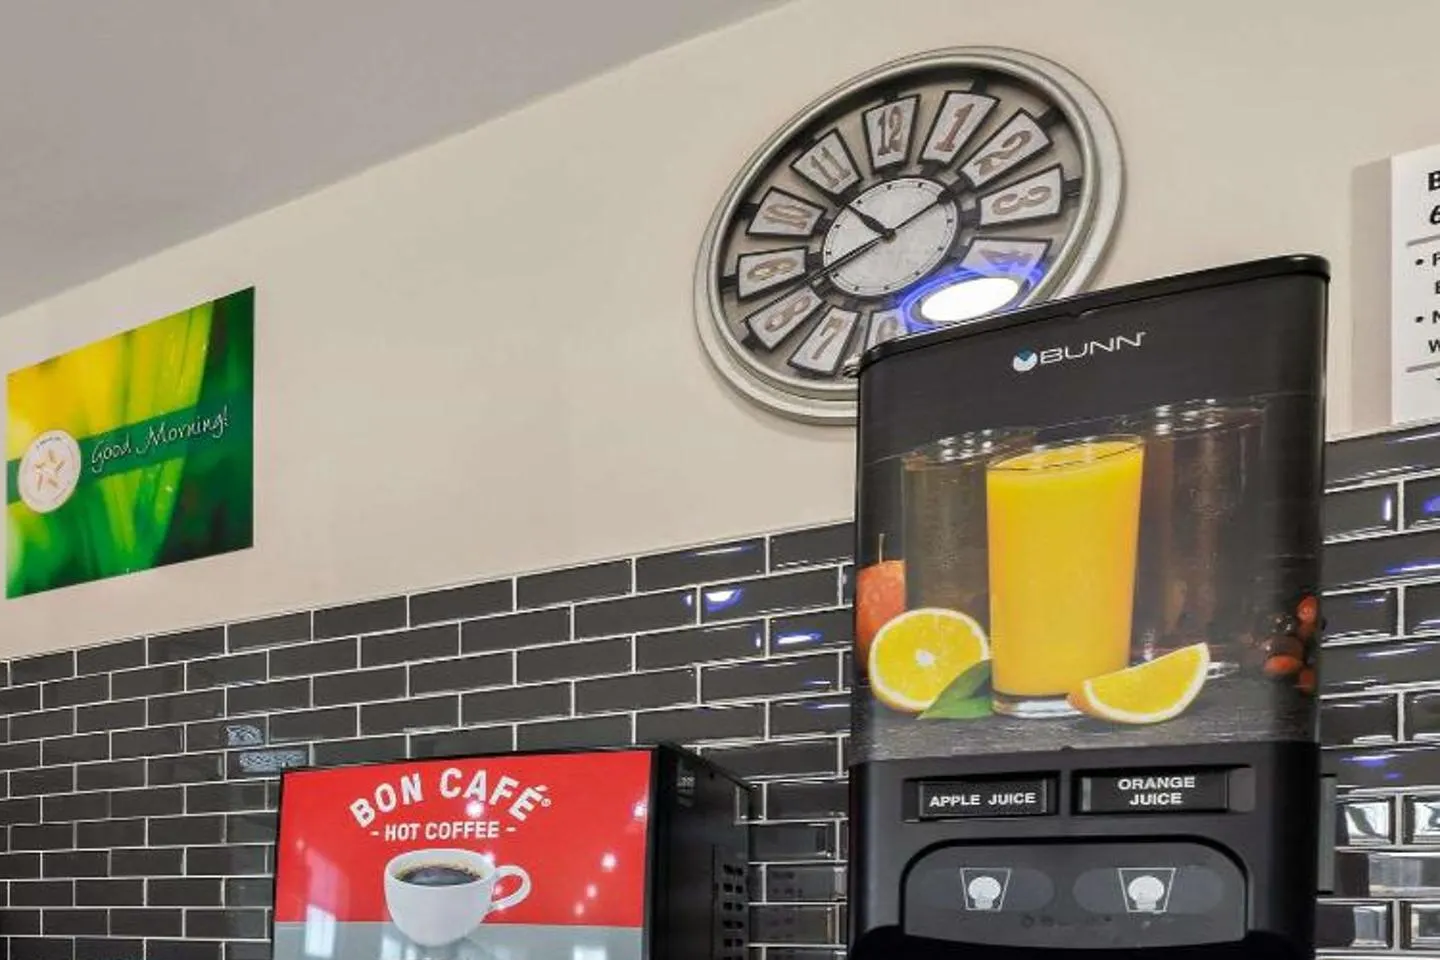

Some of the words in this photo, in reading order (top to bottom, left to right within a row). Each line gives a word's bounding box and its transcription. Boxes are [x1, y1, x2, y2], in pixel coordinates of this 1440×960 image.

[876, 105, 905, 157] 12
[933, 102, 975, 153] 1
[810, 146, 853, 188] 11
[973, 129, 1033, 178] 2
[761, 202, 813, 230] 10
[990, 185, 1053, 216] 3
[763, 295, 812, 333] 8
[811, 315, 844, 360] 7
[1040, 331, 1141, 364] BUNN
[91, 431, 132, 473] Good
[135, 404, 229, 454] Morning!
[349, 772, 425, 829] BON
[439, 767, 549, 822] CAFÉ
[929, 794, 981, 808] APPLE
[988, 792, 1037, 806] JUICE
[1117, 776, 1196, 791] ORANGE
[1129, 792, 1183, 806] JUICE
[384, 823, 421, 842] HOT
[425, 820, 500, 841] COFFEE
